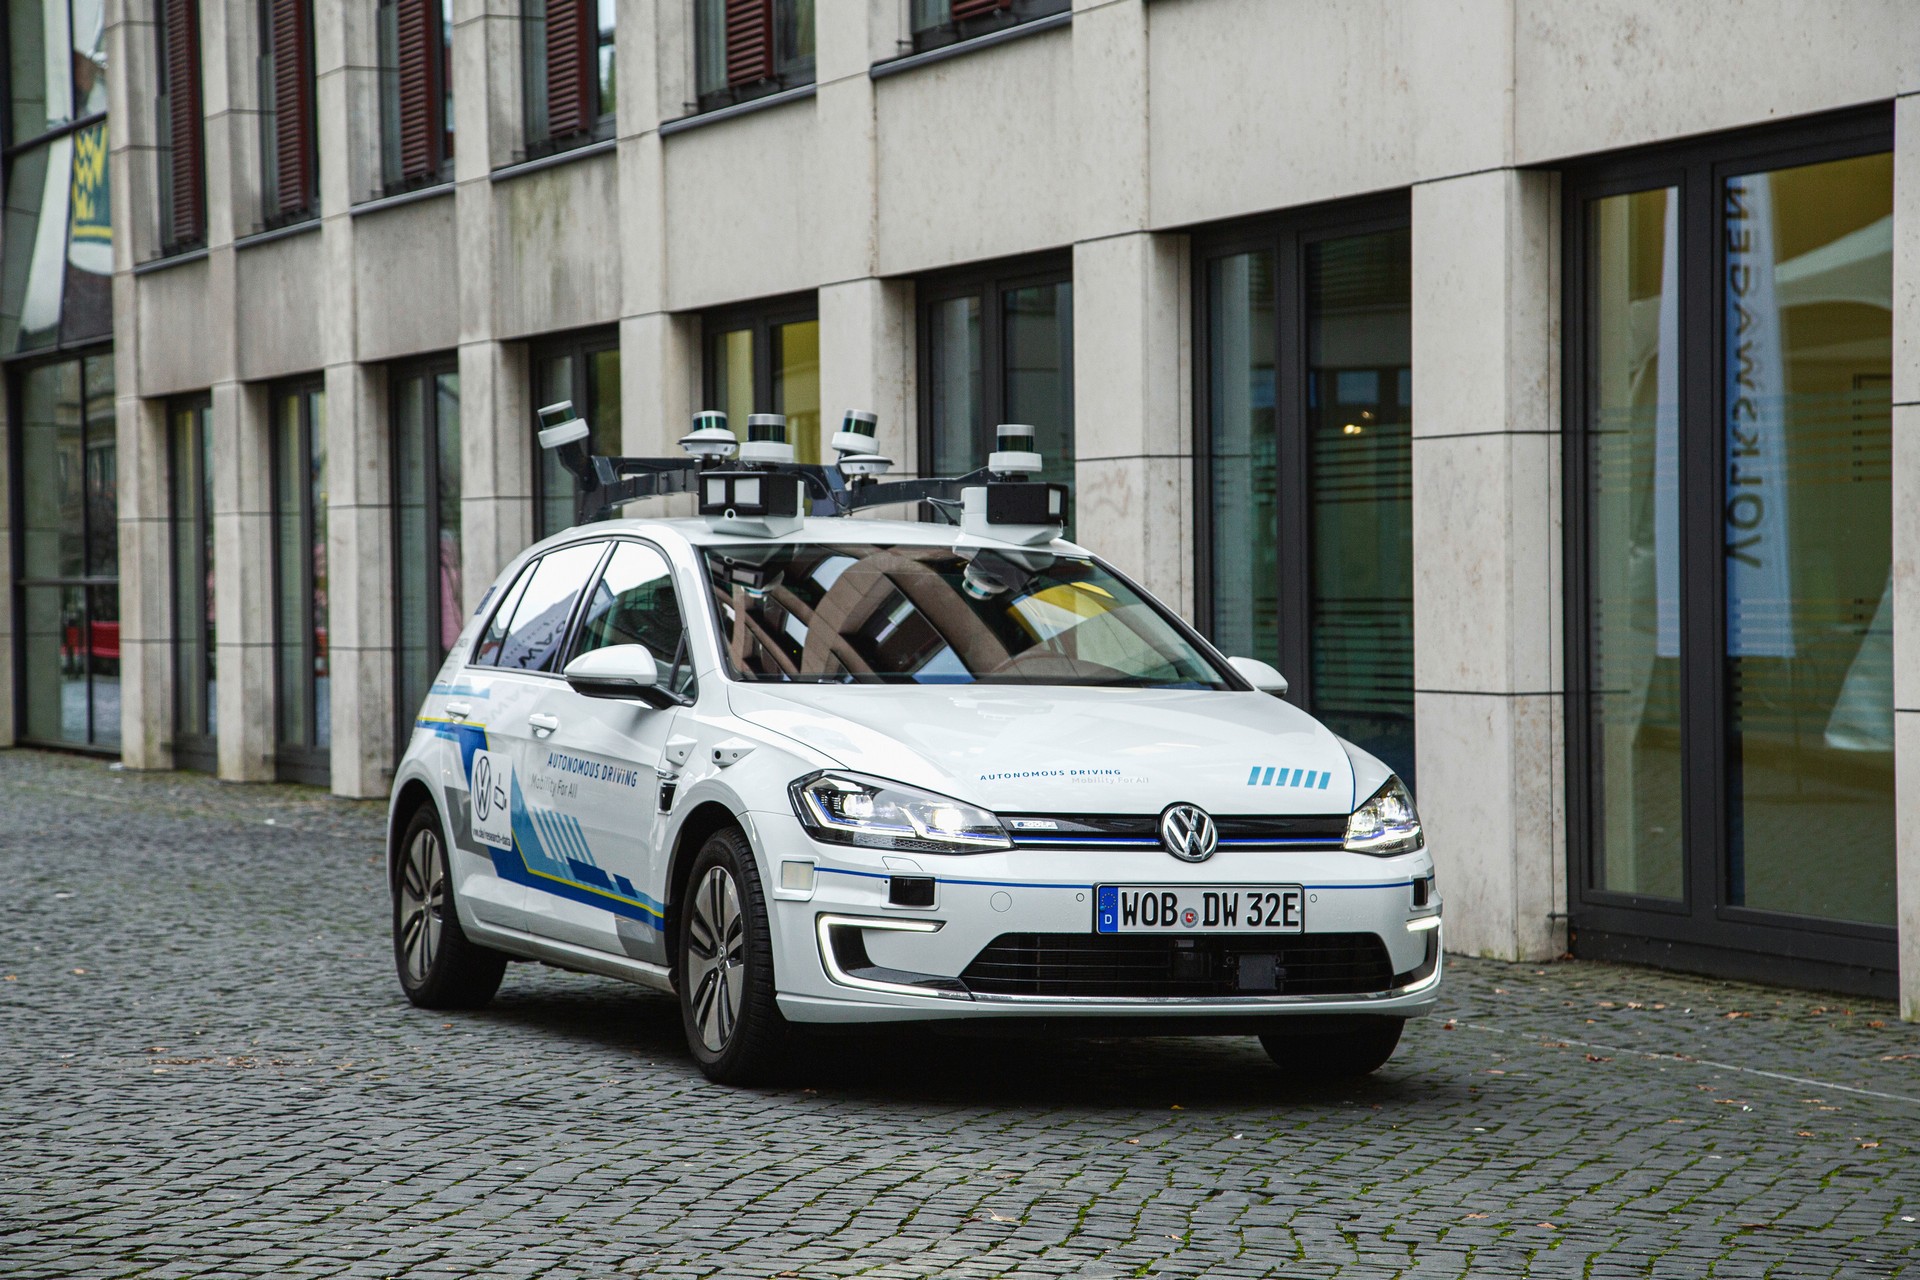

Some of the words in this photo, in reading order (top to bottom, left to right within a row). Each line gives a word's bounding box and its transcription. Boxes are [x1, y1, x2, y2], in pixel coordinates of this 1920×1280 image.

[547, 752, 600, 779] AUTONOMOUS
[601, 764, 638, 788] DRIVING
[980, 769, 1065, 781] AUTONOMOUS
[1071, 777, 1115, 785] Mobility
[530, 773, 557, 798] Mobility
[556, 780, 568, 796] For
[568, 783, 578, 799] All
[1104, 914, 1113, 925] D
[1121, 892, 1178, 926] WOB
[1202, 892, 1239, 926] DW
[1247, 893, 1299, 926] 32E
